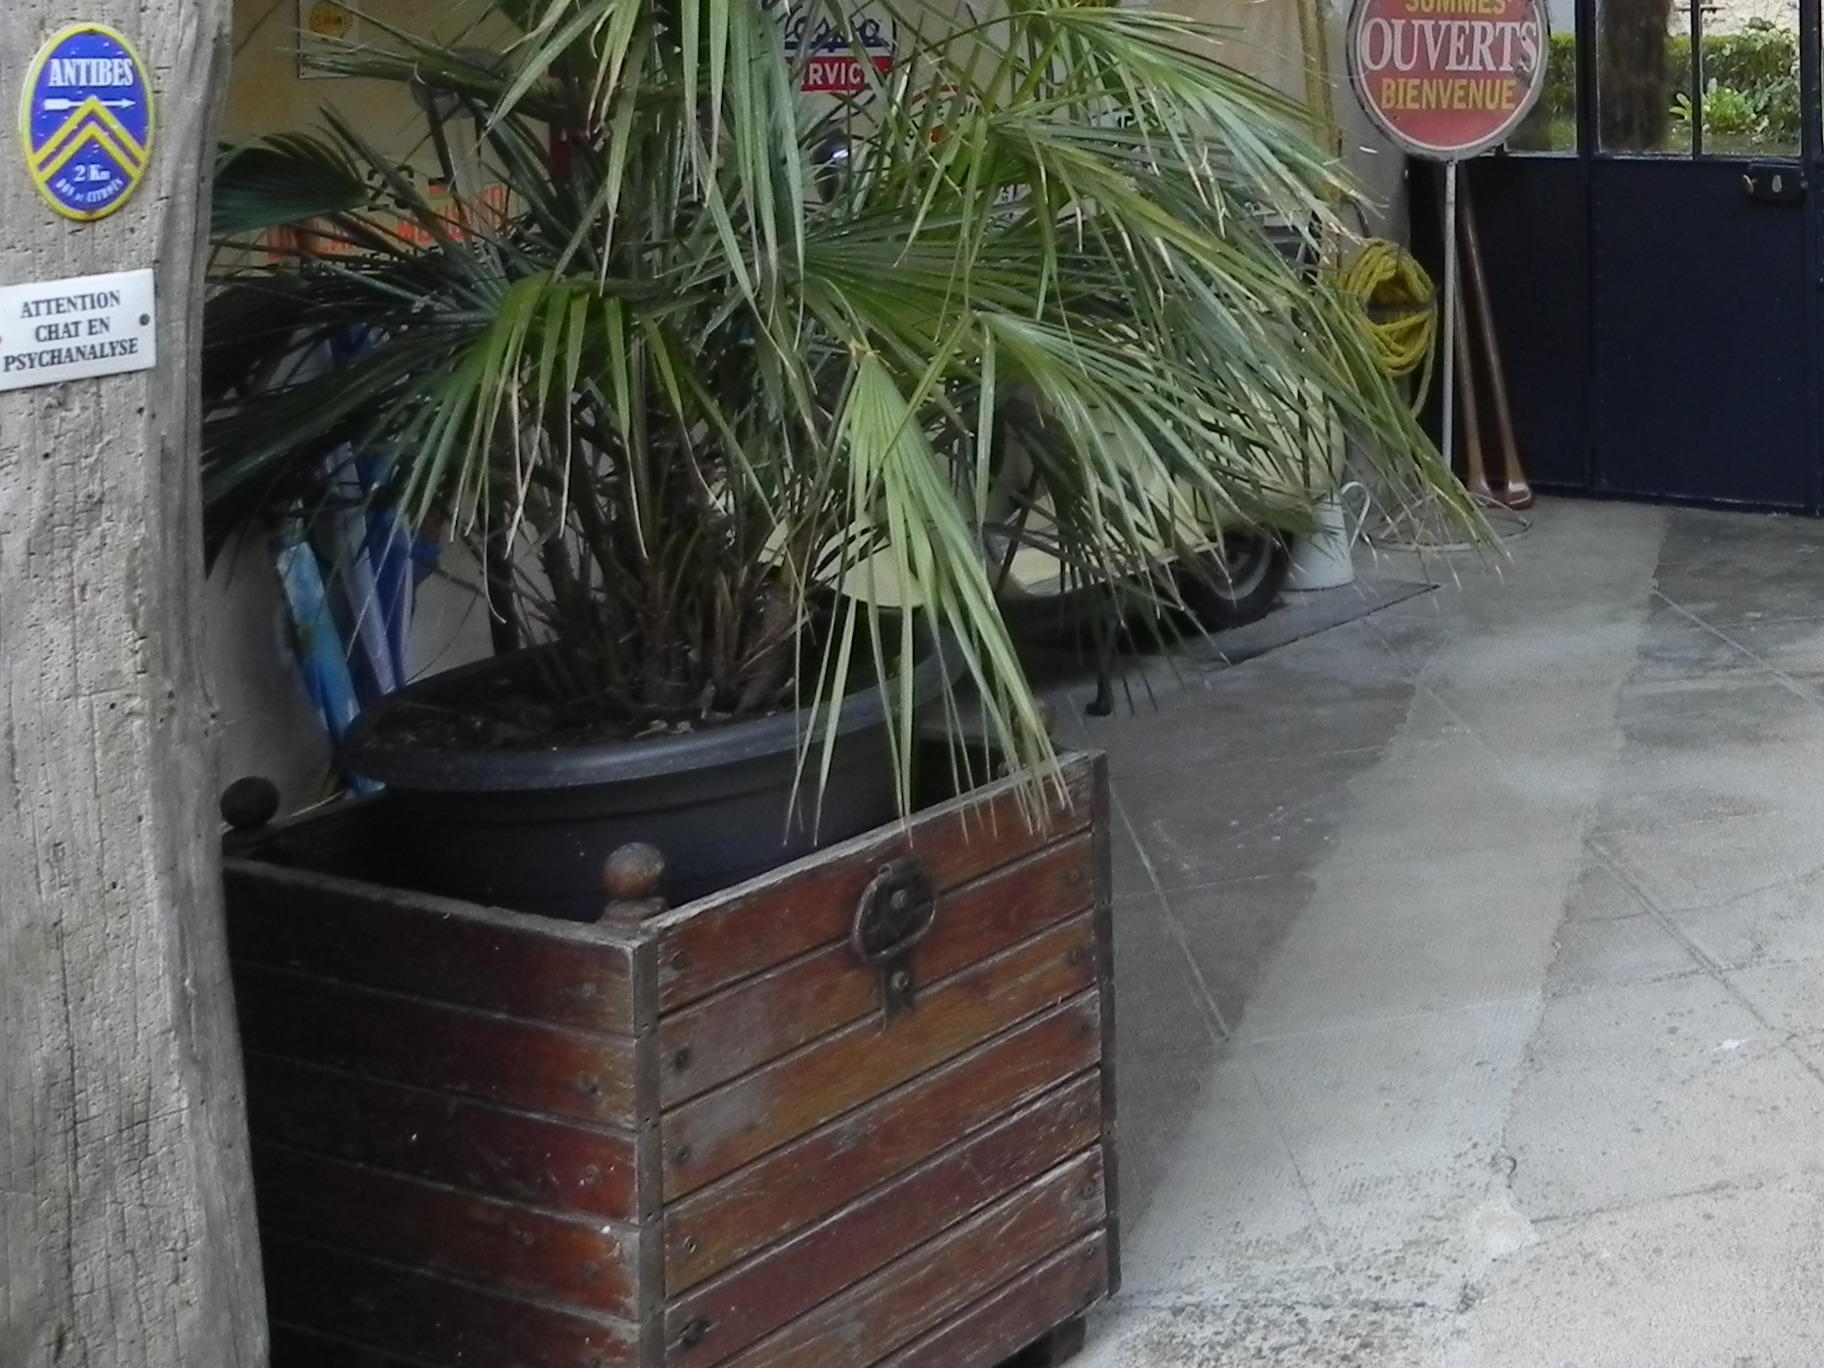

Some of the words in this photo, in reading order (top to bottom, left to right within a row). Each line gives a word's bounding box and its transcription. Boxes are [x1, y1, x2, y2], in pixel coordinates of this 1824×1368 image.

[1360, 17, 1538, 73] OUVERTS
[48, 58, 134, 88] ANTIBES
[1381, 78, 1517, 111] BIENVENUE
[74, 164, 86, 182] 2
[20, 289, 121, 319] ATTENTION
[35, 320, 81, 343] CHAT
[88, 317, 110, 335] EN
[3, 337, 138, 373] PSYCHANALYSE
